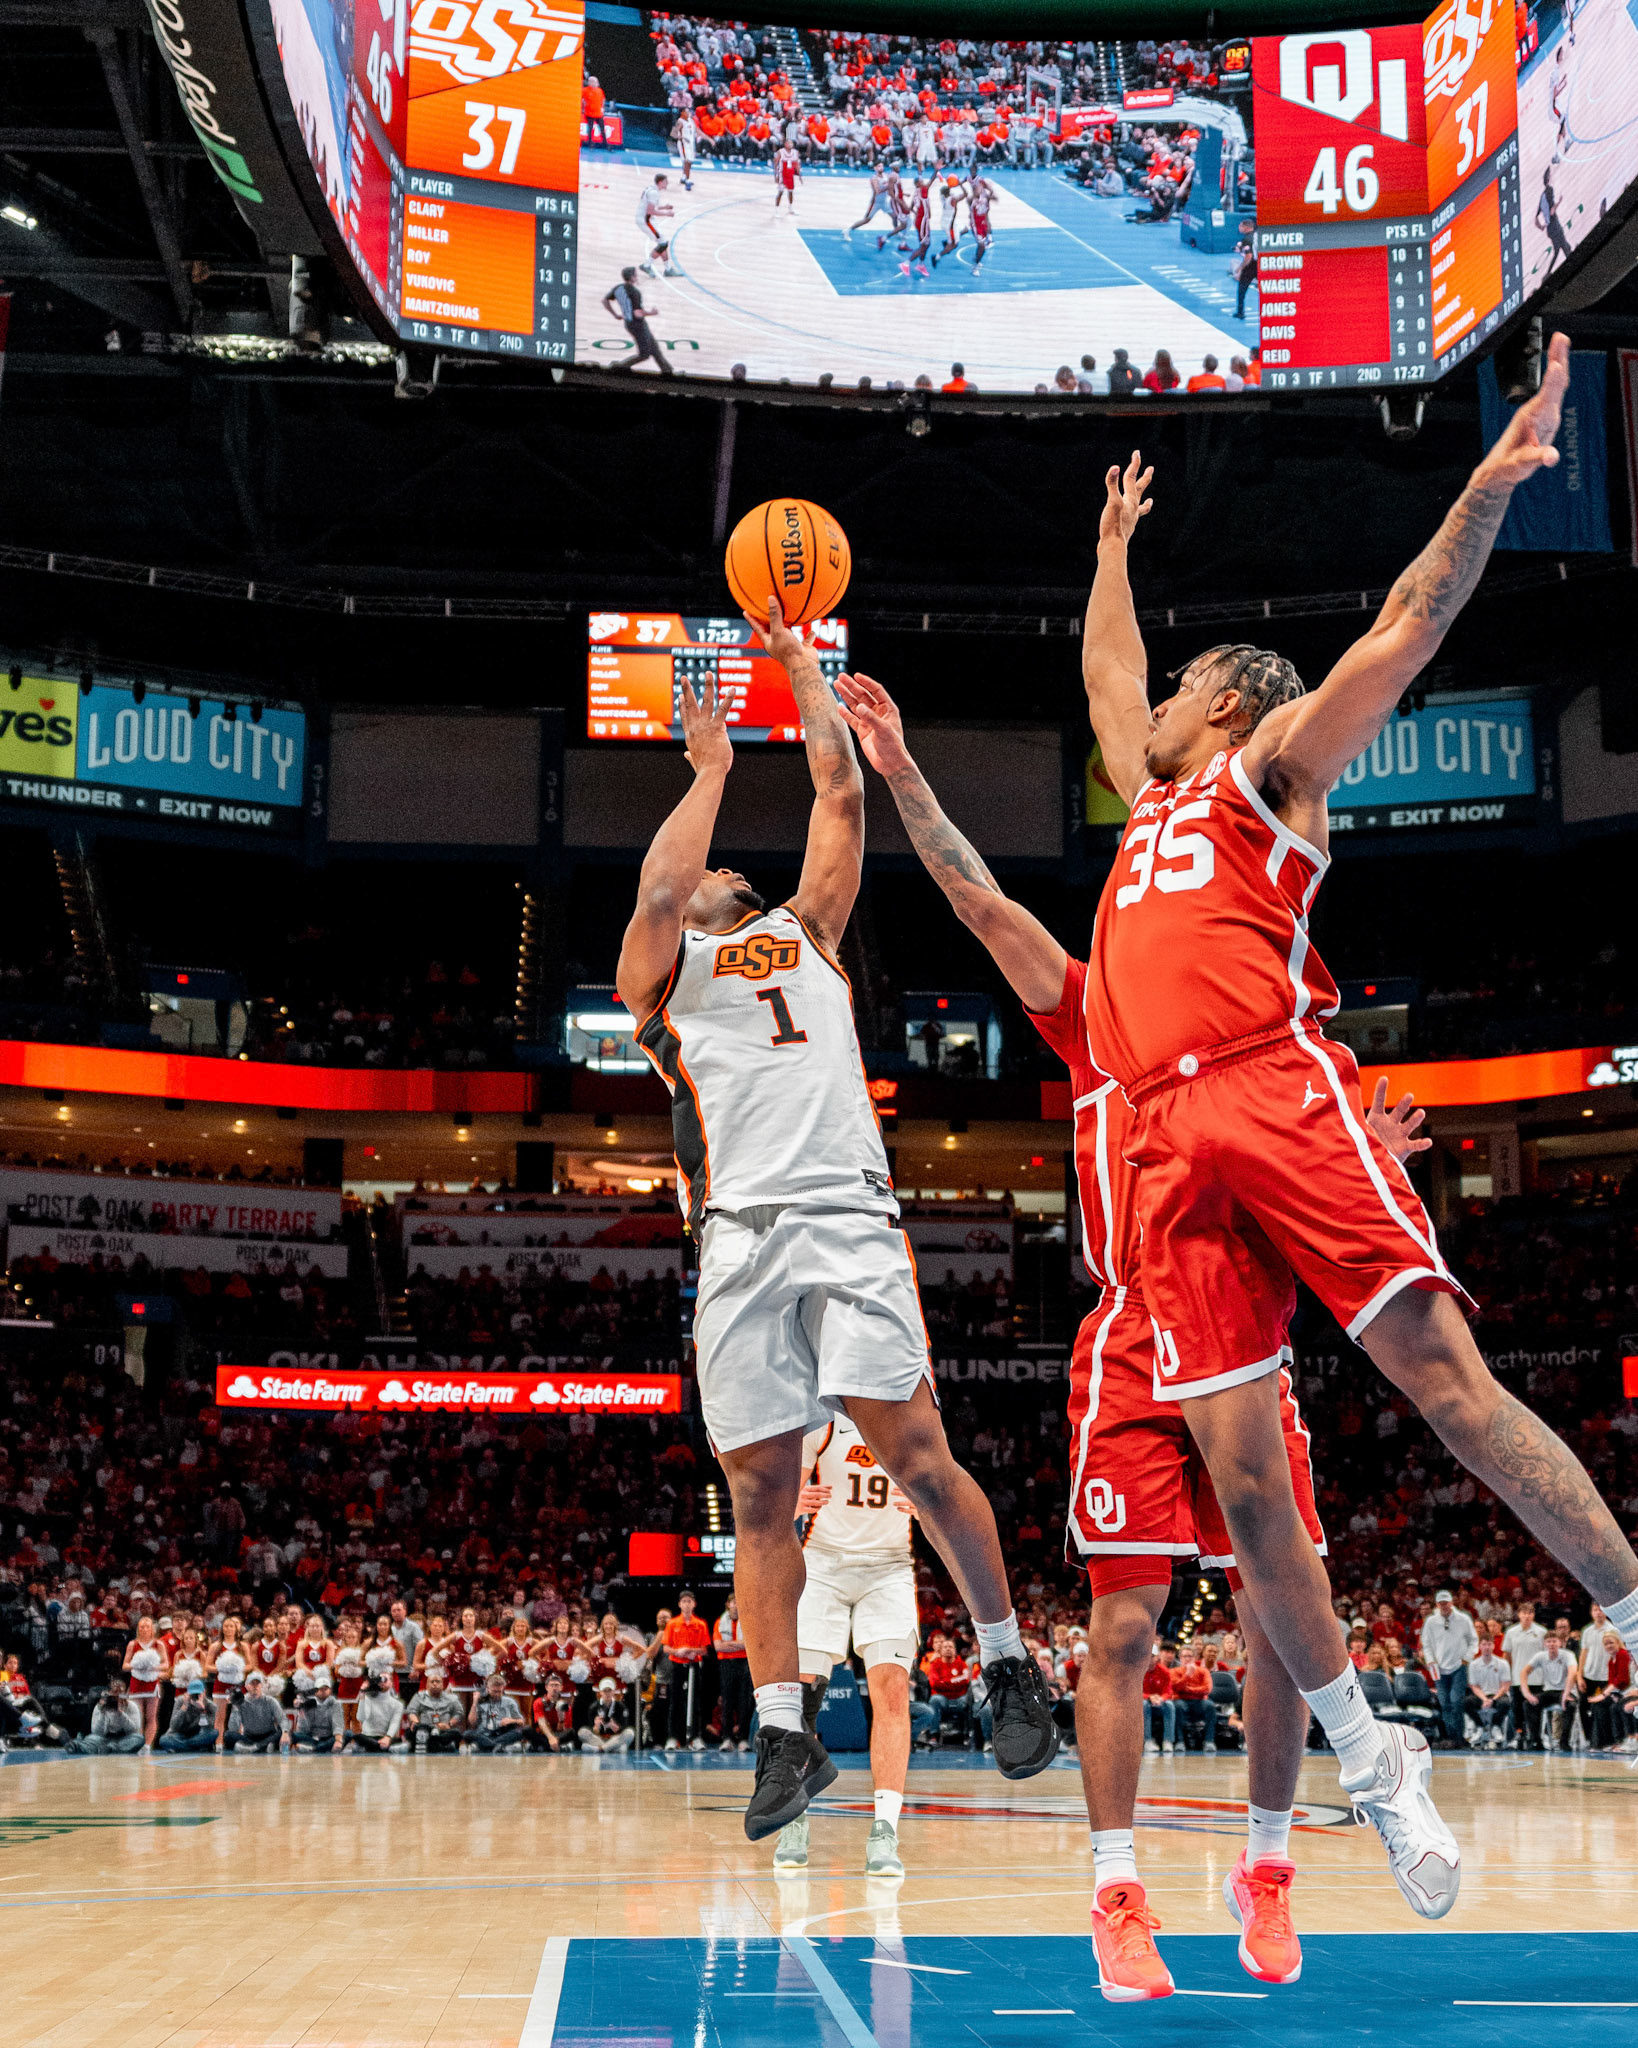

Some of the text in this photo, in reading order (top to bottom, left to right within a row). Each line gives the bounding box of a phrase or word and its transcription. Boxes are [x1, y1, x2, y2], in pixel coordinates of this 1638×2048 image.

[153, 0, 237, 144] payco
[463, 101, 527, 175] 37
[1457, 81, 1489, 176] 37
[411, 176, 574, 215] PLAYER PTS FL
[1303, 144, 1380, 214] 46
[409, 200, 571, 239] CLARY 6 2
[1261, 223, 1427, 247] PLAYER PTS FL
[408, 224, 571, 262] MILLER 7 1
[1260, 246, 1423, 271] BROWN 10 1
[407, 248, 571, 285] ROY 13 0
[1260, 270, 1423, 294] WAGUE 4 1
[406, 273, 570, 310] VUKOVIC 4 0
[1261, 293, 1424, 317] JONES 9 1
[412, 322, 429, 338] TO
[434, 325, 443, 340] 3
[451, 327, 465, 343] TF
[470, 331, 480, 346] 0
[500, 334, 525, 351] 2ND
[536, 340, 568, 357] 17:27
[541, 316, 549, 331] 2
[563, 319, 570, 333] 1
[1262, 316, 1426, 341] DAVIS 2 0
[1262, 340, 1427, 364] REID 5 0
[1270, 364, 1426, 387] TO 3 TF 1 2ND 17:27
[1565, 407, 1581, 490] OKLAHOMA
[781, 507, 806, 588] Wilson
[635, 619, 672, 643] 37
[696, 629, 742, 644] 17:27
[88, 707, 294, 791] LOUD CITY
[1330, 718, 1524, 791] OUD CITY
[7, 779, 271, 825] THUNDER EXIT NOW
[1391, 808, 1445, 827] EXIT
[1450, 803, 1506, 823] NOW
[1116, 799, 1215, 909] 35
[713, 932, 801, 981] OSU
[756, 987, 808, 1046] 1
[151, 1201, 216, 1230] PARTY
[224, 1207, 318, 1235] TERRACE
[846, 1472, 890, 1509] 19
[1084, 1478, 1127, 1533] OU
